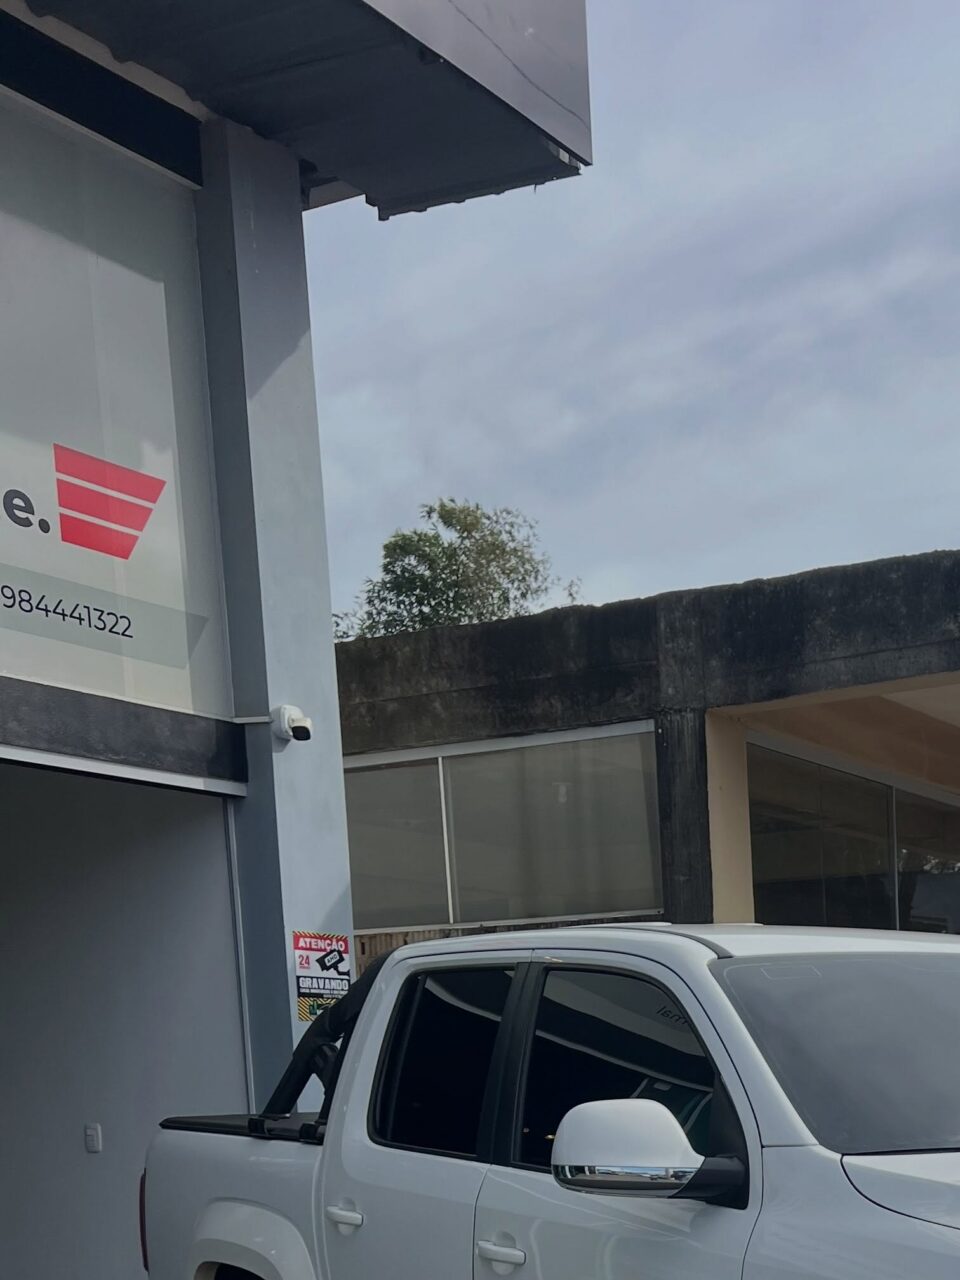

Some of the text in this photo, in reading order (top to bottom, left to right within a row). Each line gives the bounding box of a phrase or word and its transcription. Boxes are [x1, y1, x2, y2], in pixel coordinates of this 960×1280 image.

[3, 488, 51, 534] e.
[0, 585, 134, 639] 984441322
[298, 936, 345, 953] ATENÇÃO
[298, 954, 310, 967] 24
[299, 977, 349, 991] GRAVANDO
